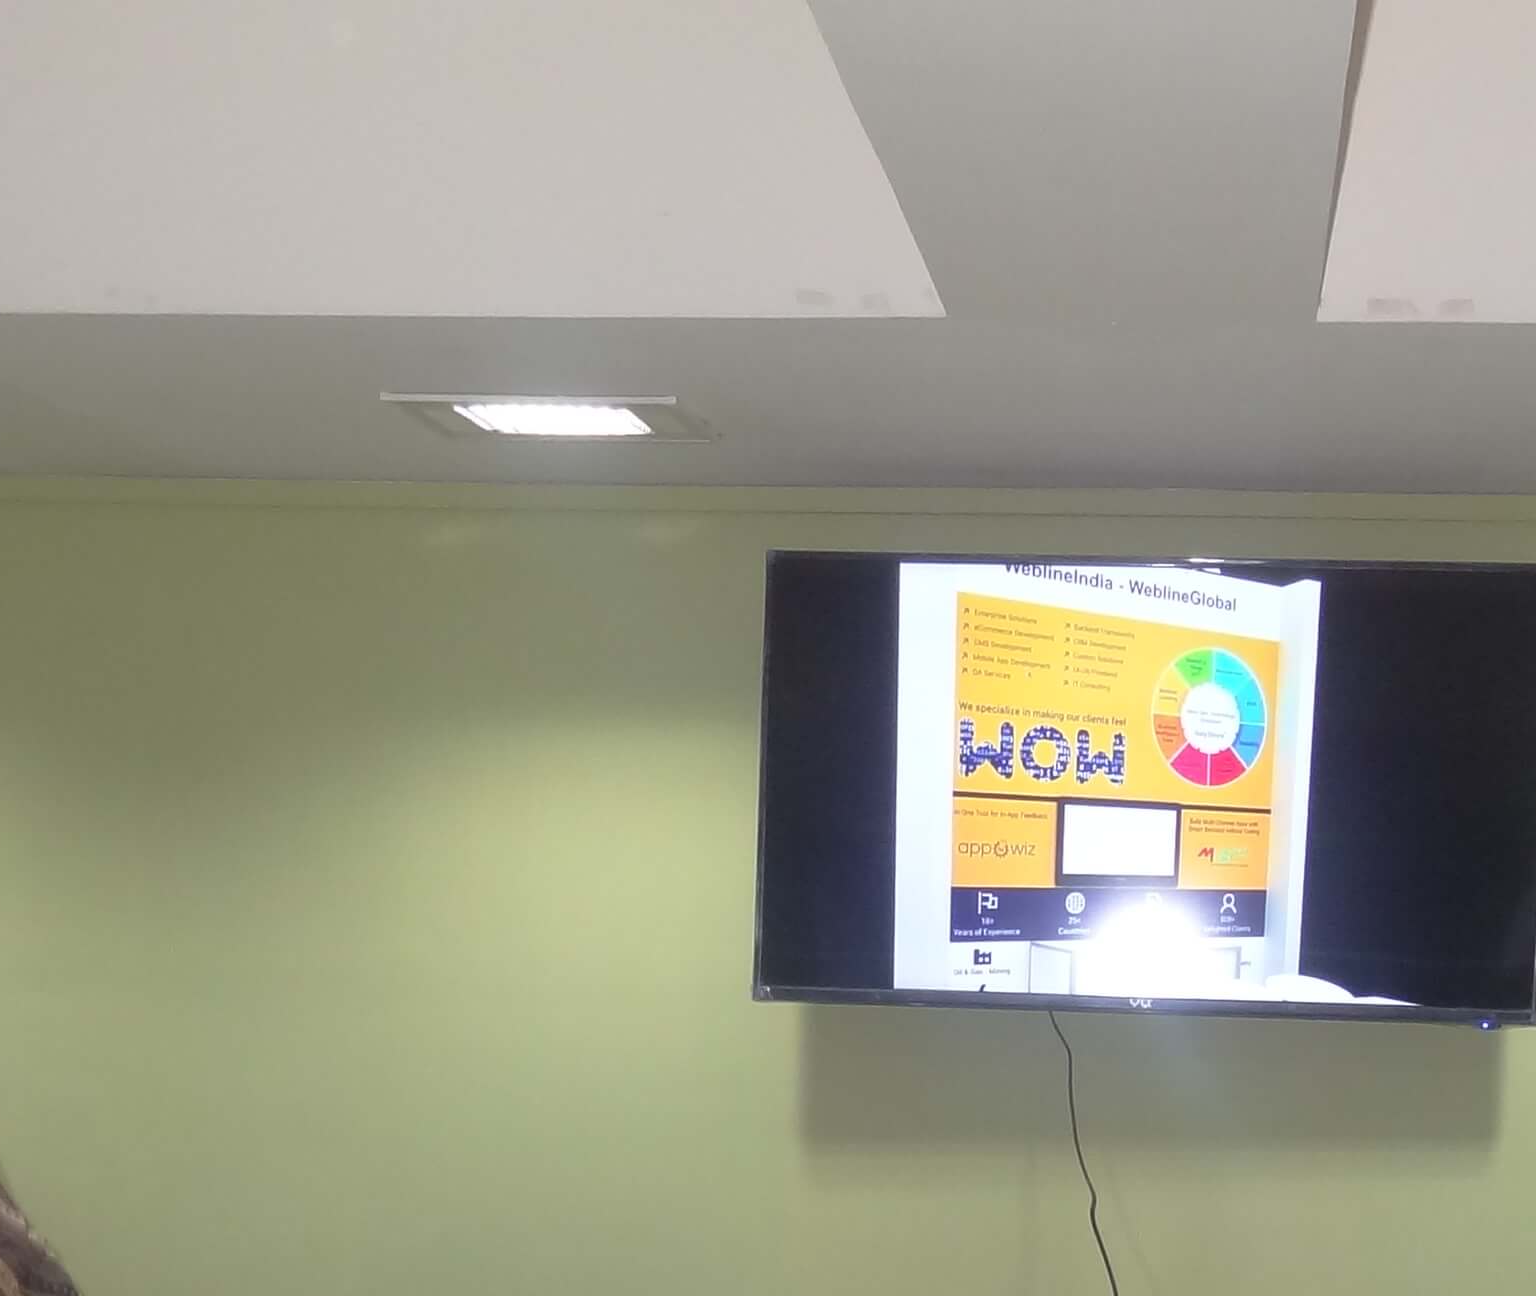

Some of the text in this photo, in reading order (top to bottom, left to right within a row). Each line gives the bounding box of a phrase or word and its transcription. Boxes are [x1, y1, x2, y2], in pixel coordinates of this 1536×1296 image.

[1005, 564, 1113, 590] WeblineIndia
[1128, 579, 1237, 612] WeblineGlobal
[959, 702, 973, 711] We
[975, 706, 1020, 716] specialize
[1033, 710, 1064, 722] making
[1082, 715, 1109, 725] clients
[1111, 717, 1127, 726] feel
[960, 718, 1125, 784] WOW
[974, 928, 982, 936] of
